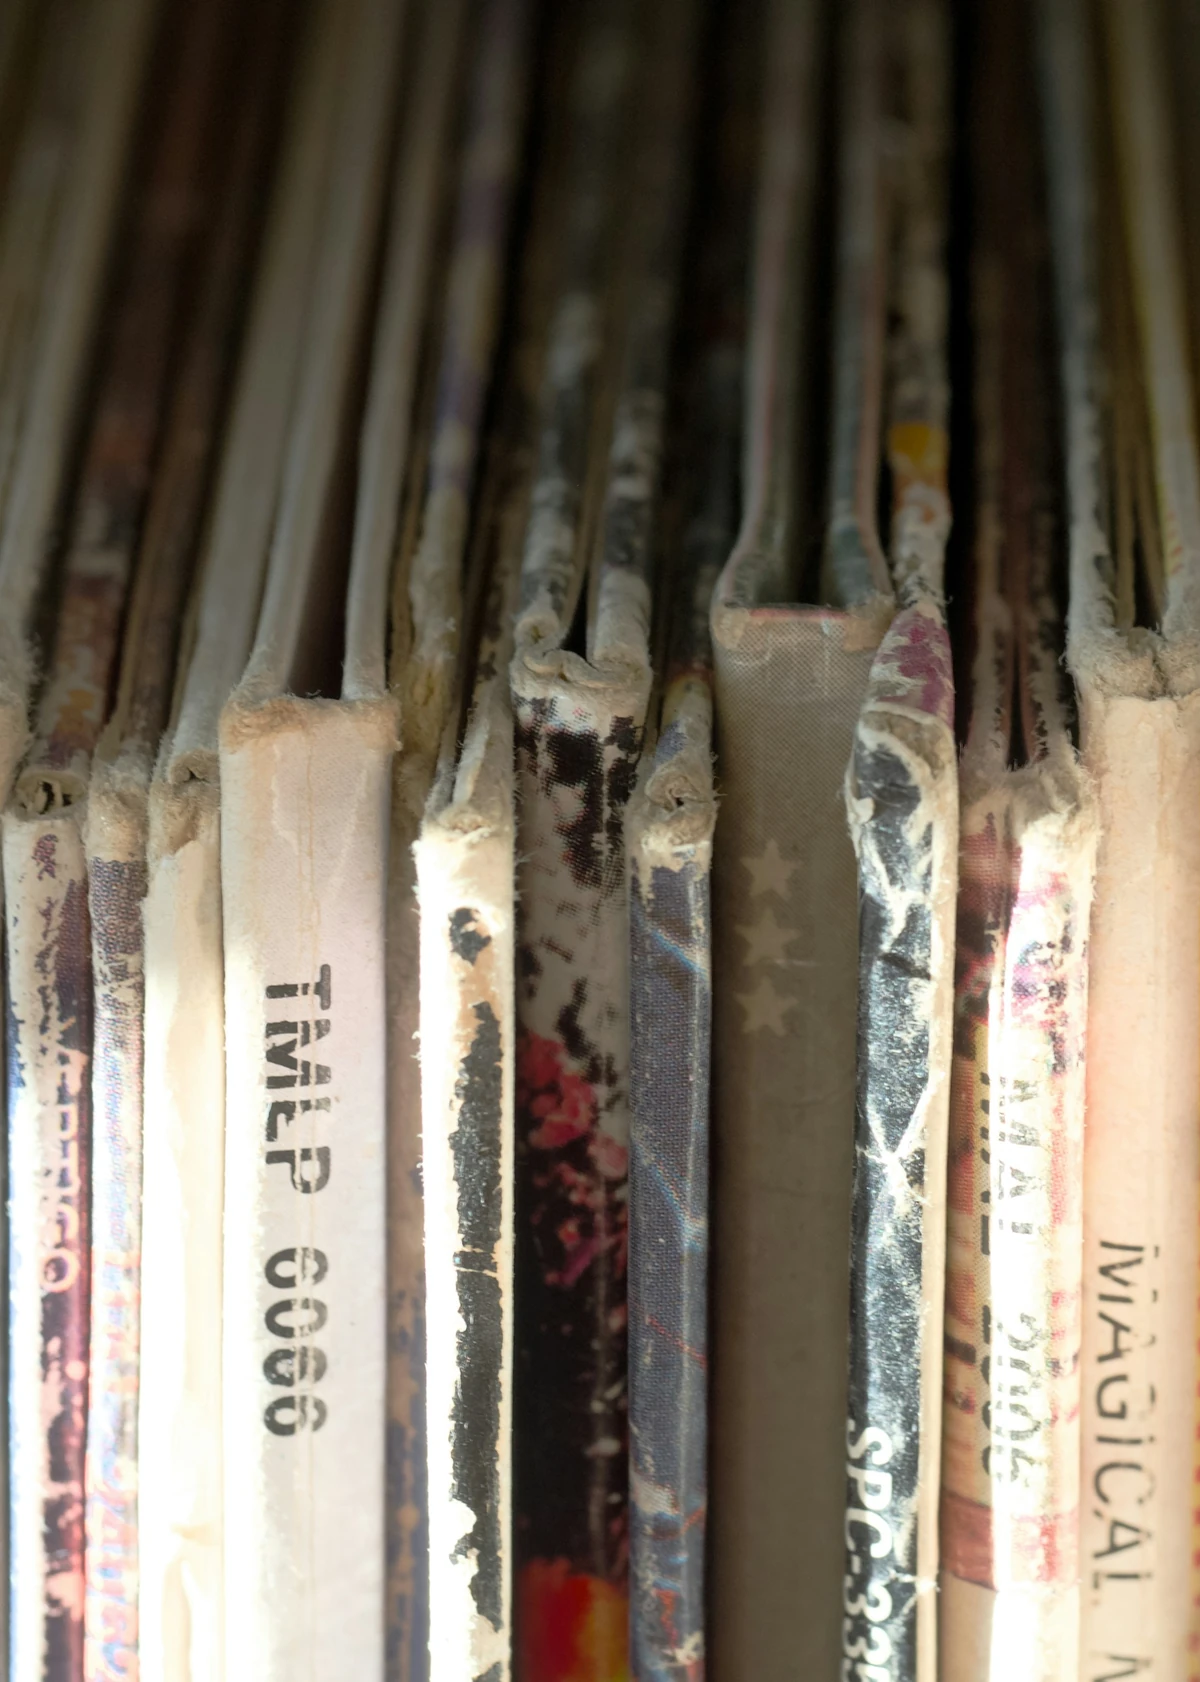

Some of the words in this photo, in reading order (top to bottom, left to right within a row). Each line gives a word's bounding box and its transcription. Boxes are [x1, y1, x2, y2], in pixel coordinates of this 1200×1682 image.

[264, 963, 332, 1194] TMLP
[981, 1072, 1048, 1257] MAL
[1092, 1239, 1160, 1592] MAGICAL
